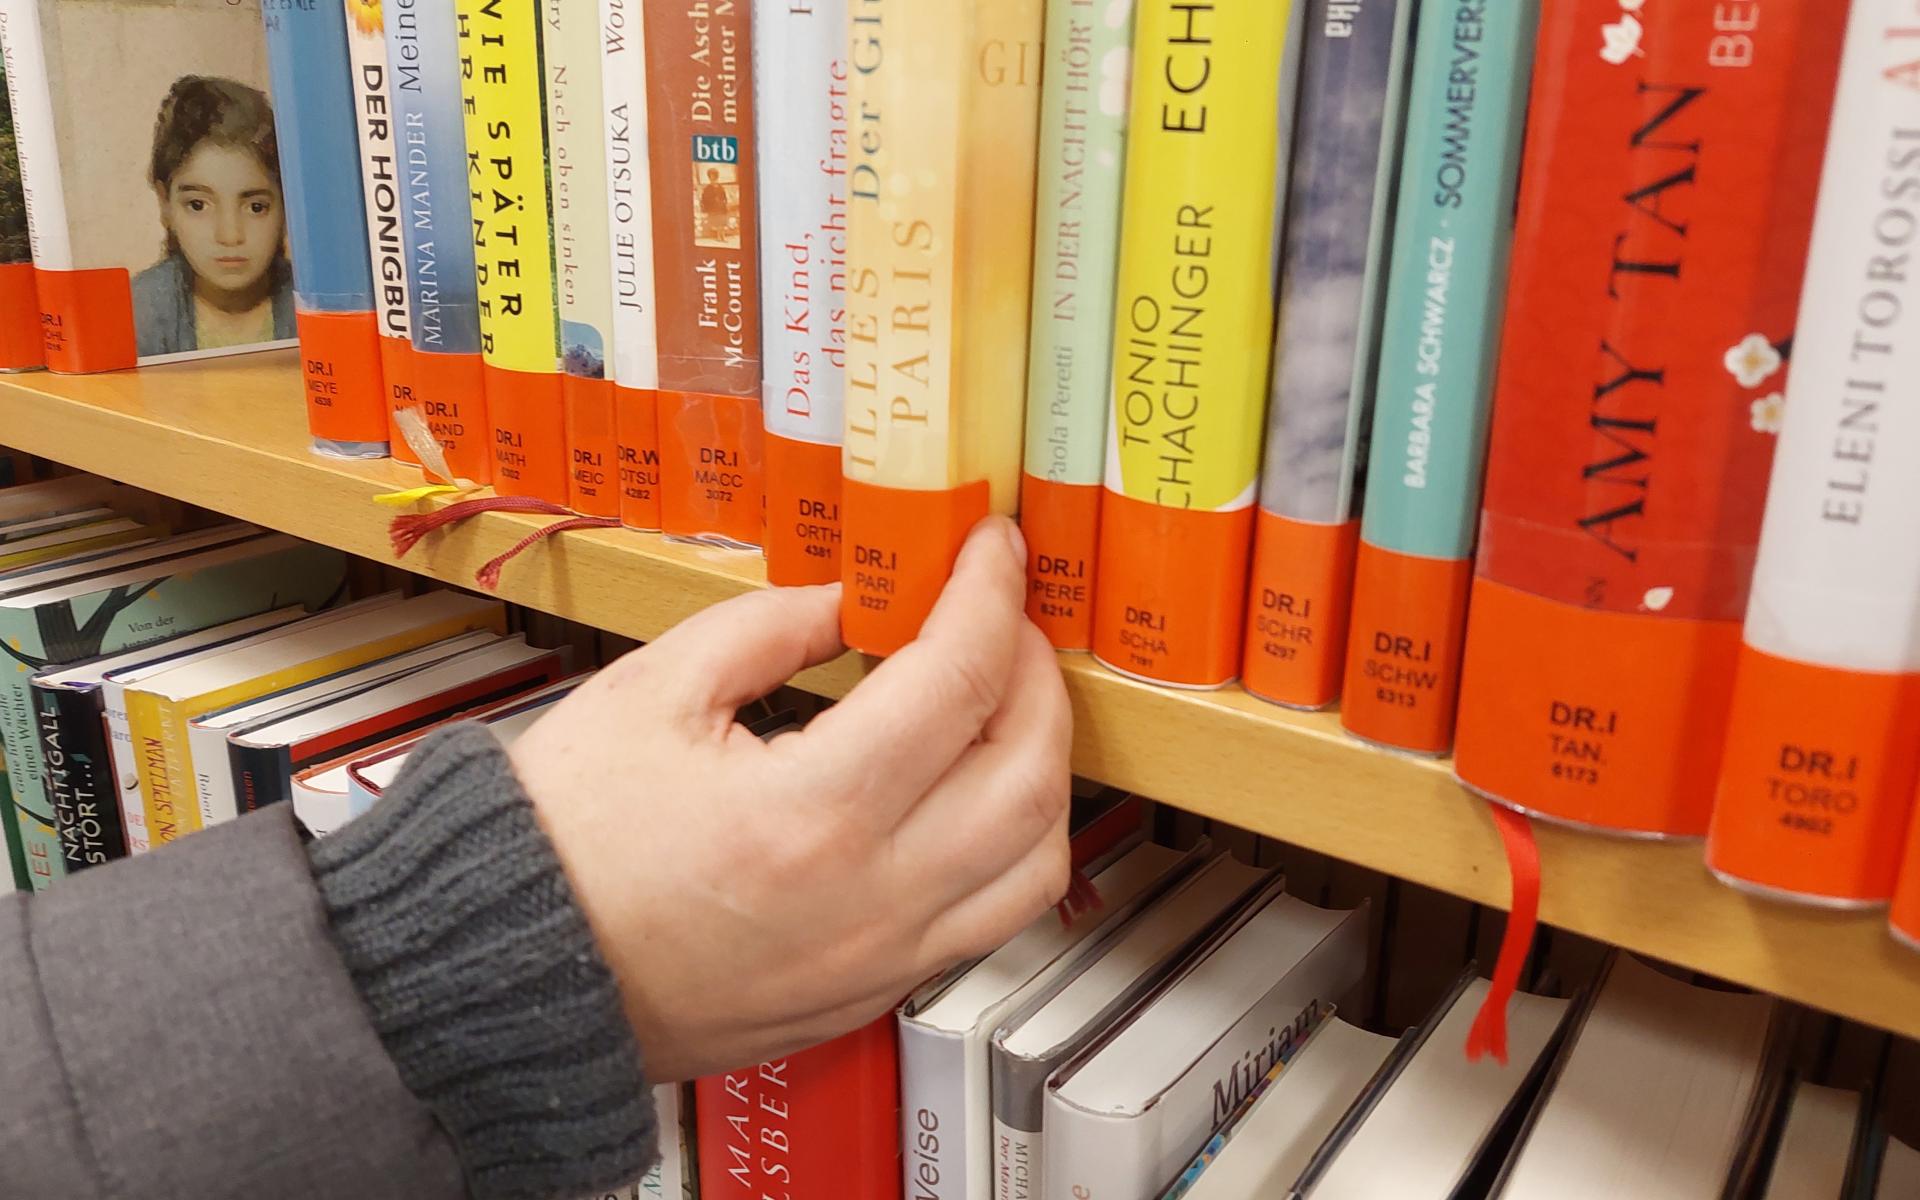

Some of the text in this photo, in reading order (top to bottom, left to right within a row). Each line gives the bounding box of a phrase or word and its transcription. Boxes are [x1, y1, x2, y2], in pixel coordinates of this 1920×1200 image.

[547, 0, 561, 31] ry
[852, 0, 883, 75] Gl
[1708, 0, 1761, 68] BE
[4, 46, 19, 115] Mädchen
[687, 1, 713, 122] Die Asch
[717, 25, 738, 124] meiner
[1162, 4, 1215, 134] ECH
[14, 121, 25, 145] mit
[1434, 0, 1487, 209] SOMMERVER
[19, 151, 29, 181] dem
[697, 136, 736, 161] btb
[851, 100, 881, 206] Der
[1060, 99, 1087, 211] NACHT
[362, 64, 408, 339] DER HONIGBU
[553, 64, 579, 305] Nach oben sinken
[610, 102, 643, 313] JULIE OTSUKA
[25, 187, 41, 258] Fingerhut
[406, 112, 443, 345] MARINA MANDER
[487, 120, 524, 316] SPÄTER
[820, 192, 847, 292] nicht
[467, 150, 495, 355] KINDER
[1055, 221, 1081, 280] DER
[695, 258, 719, 328] Frank
[723, 261, 744, 369] McCourt
[1053, 288, 1076, 321] IN
[1576, 75, 1708, 563] AMY TAN
[785, 232, 814, 421] Das Kind,
[821, 308, 847, 369] das
[891, 218, 934, 428] PARIS
[1821, 127, 1920, 526] ELENI TOROSSI
[307, 359, 333, 377] DR.I
[1050, 344, 1075, 417] Peretti
[1123, 295, 1161, 447] TONIO
[1402, 235, 1456, 489] BARBARA SCHWARCZ
[425, 401, 459, 418] DR.I
[495, 428, 523, 448] DR.I
[573, 449, 603, 466] DR.I
[573, 468, 605, 485] MEIC
[694, 470, 744, 488] MACC
[699, 447, 738, 468] DR.I
[705, 489, 733, 502] 3072
[798, 498, 839, 521] DR.I
[795, 522, 842, 544] ORTH
[855, 544, 897, 571] DR.I
[855, 570, 896, 595] PARI
[1032, 579, 1087, 602] PERE
[1037, 553, 1084, 579] DR.I
[127, 615, 175, 633] Von der
[1124, 606, 1166, 632] DR.I
[1256, 613, 1313, 645] SCHR
[1261, 588, 1311, 619] DR.I
[1118, 628, 1169, 656] SCHA
[1374, 631, 1431, 662] DR.I
[1363, 658, 1438, 690] SCHW
[1550, 700, 1617, 734] DR.I
[25, 744, 39, 780] einen
[40, 705, 83, 862] NACHTIGALL
[143, 736, 175, 816] SPIELMAN
[1779, 744, 1858, 781] DR.I
[199, 772, 214, 820] Robert
[1767, 776, 1858, 815] TORO
[1211, 998, 1319, 1131] Miriam
[725, 1073, 752, 1189] MAR
